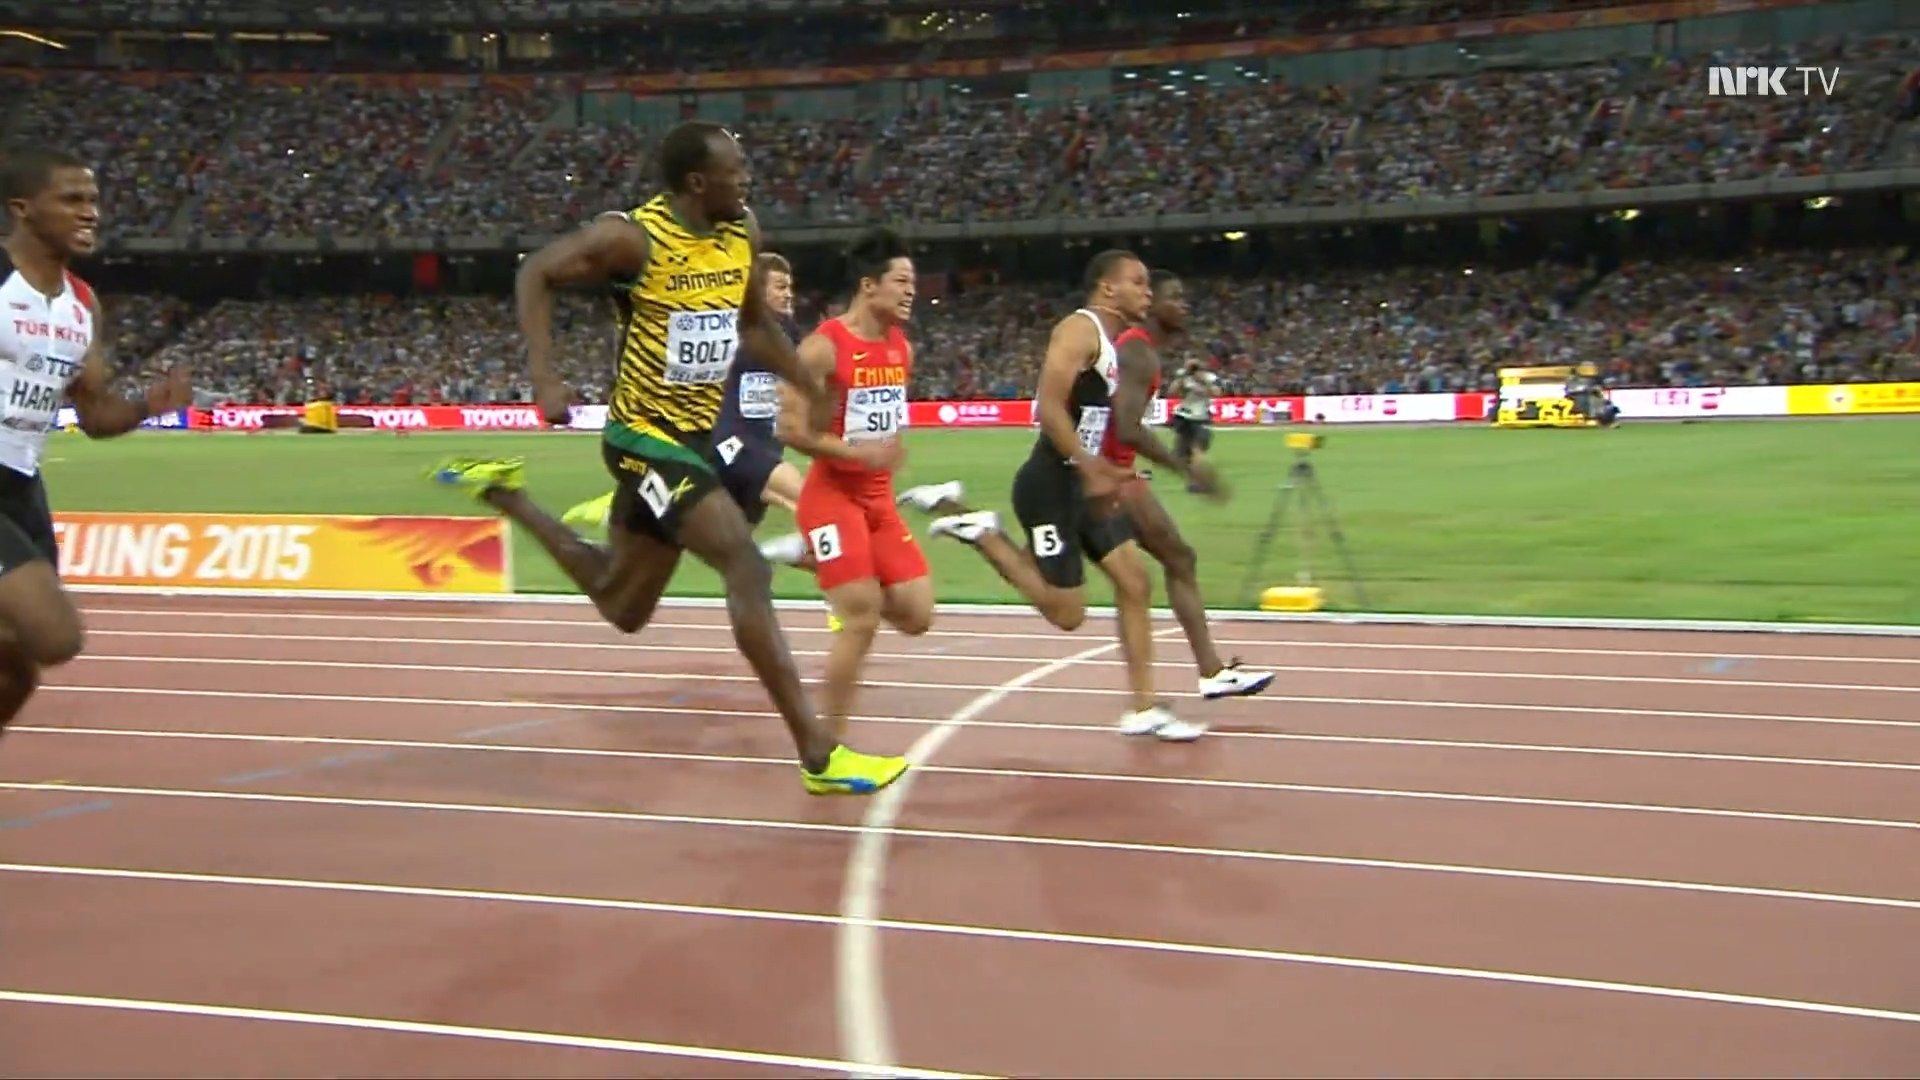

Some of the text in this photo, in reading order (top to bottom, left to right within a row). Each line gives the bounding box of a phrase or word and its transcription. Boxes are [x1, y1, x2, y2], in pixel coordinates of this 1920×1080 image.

[664, 268, 743, 291] JAMAICA
[695, 312, 733, 331] TDK
[679, 339, 731, 364] BOLT
[854, 366, 905, 387] CHINA
[868, 388, 902, 403] TDK
[460, 408, 538, 427] TOYOTA
[867, 411, 891, 432] SU
[645, 480, 664, 507] 7
[195, 523, 320, 581] 2015
[818, 532, 832, 556] 6
[1043, 530, 1057, 552] 5
